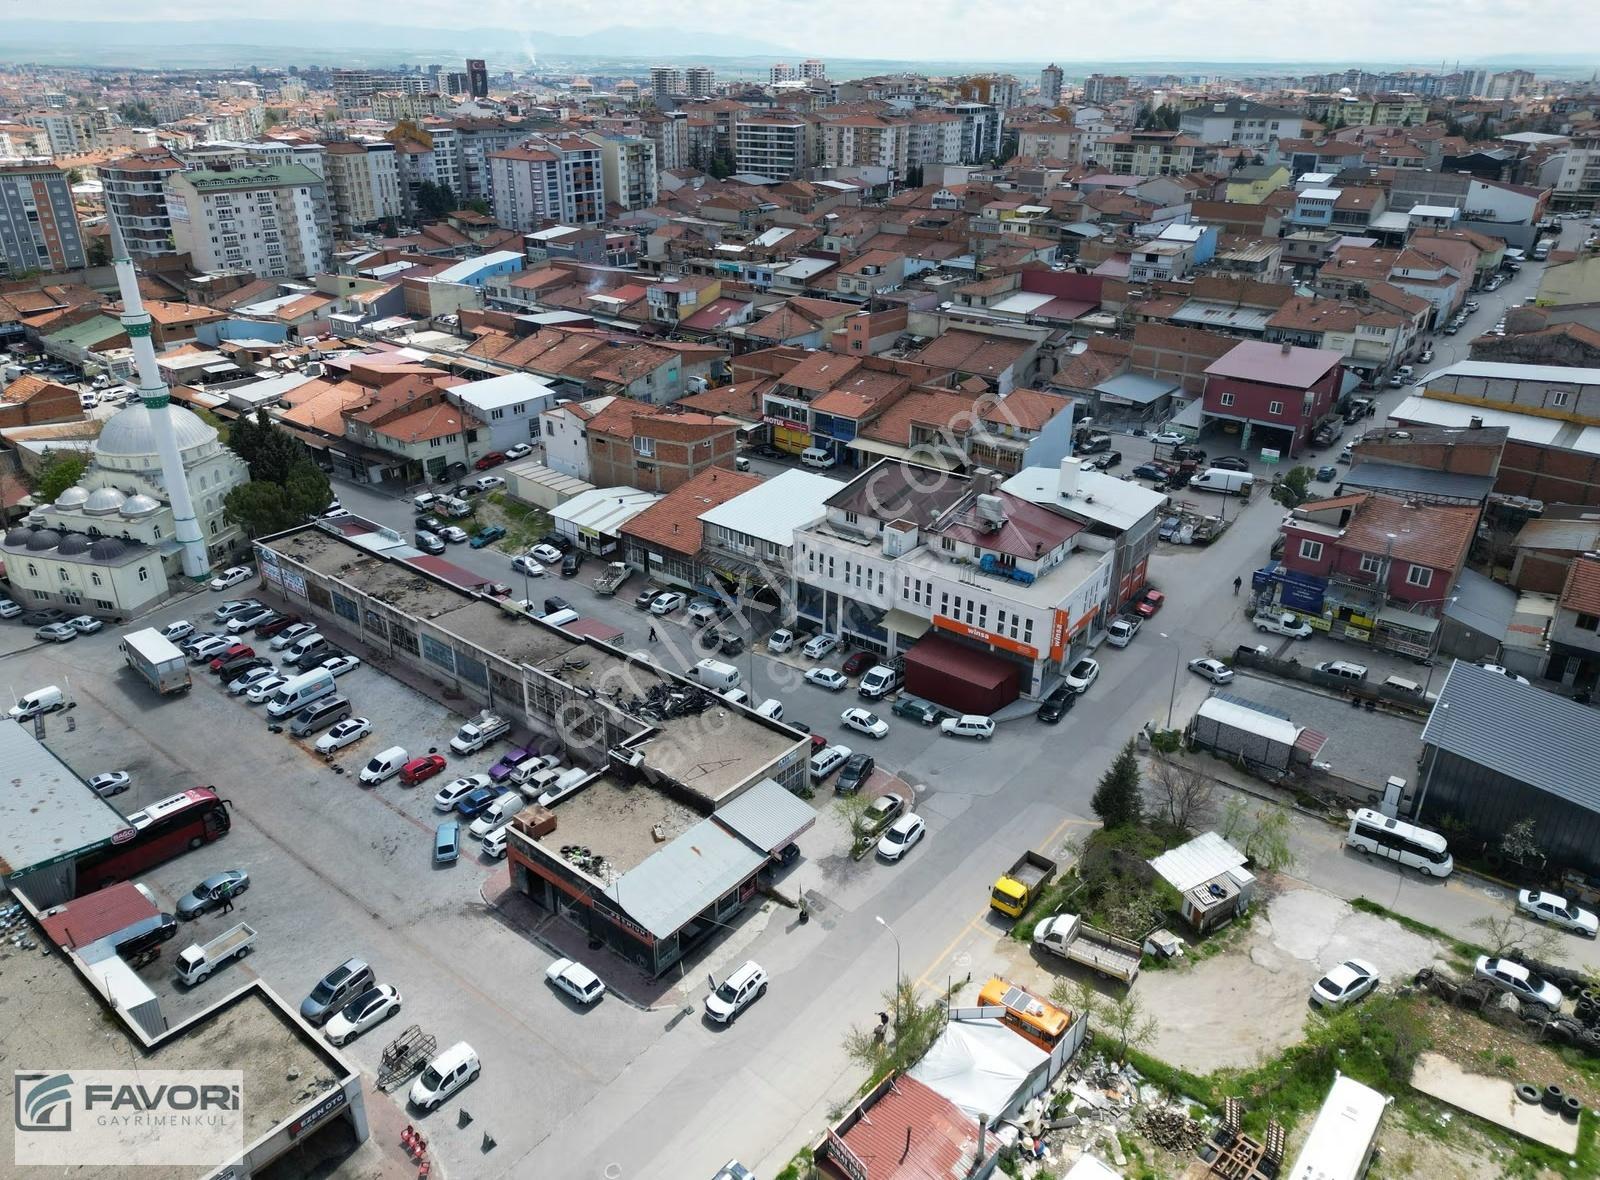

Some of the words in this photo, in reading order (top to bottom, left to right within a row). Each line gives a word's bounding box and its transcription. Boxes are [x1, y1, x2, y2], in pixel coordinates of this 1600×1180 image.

[763, 415, 784, 427] MOTUL
[967, 627, 990, 640] winsa
[1054, 624, 1063, 647] winsa
[325, 1094, 343, 1110] OTO
